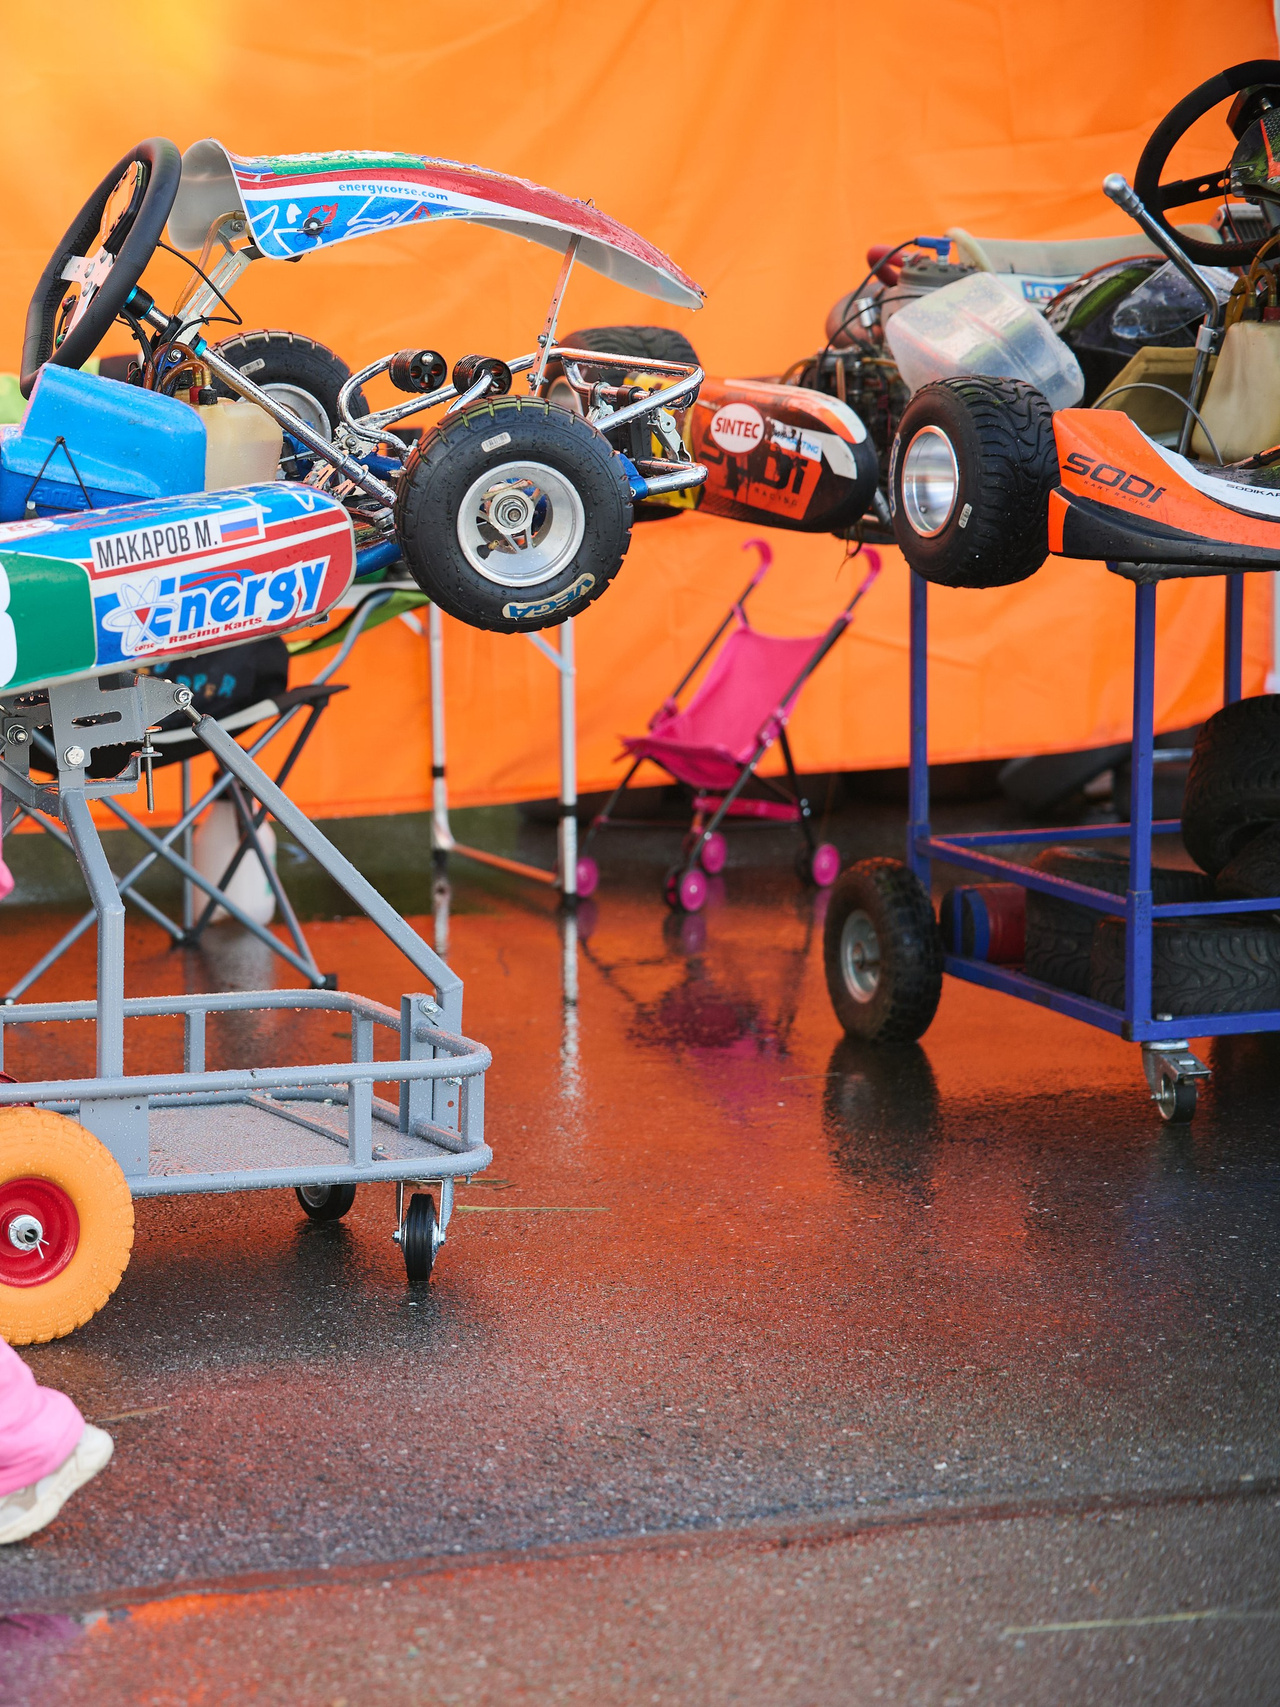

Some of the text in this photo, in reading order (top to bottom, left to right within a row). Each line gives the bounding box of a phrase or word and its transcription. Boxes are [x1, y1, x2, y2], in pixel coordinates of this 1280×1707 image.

[338, 182, 448, 201] energycorse.com
[714, 417, 761, 440] SINTEC
[1084, 480, 1152, 509] KART RACING
[96, 519, 218, 569] МАКАРОВ М.
[169, 616, 262, 644] Racing Karts
